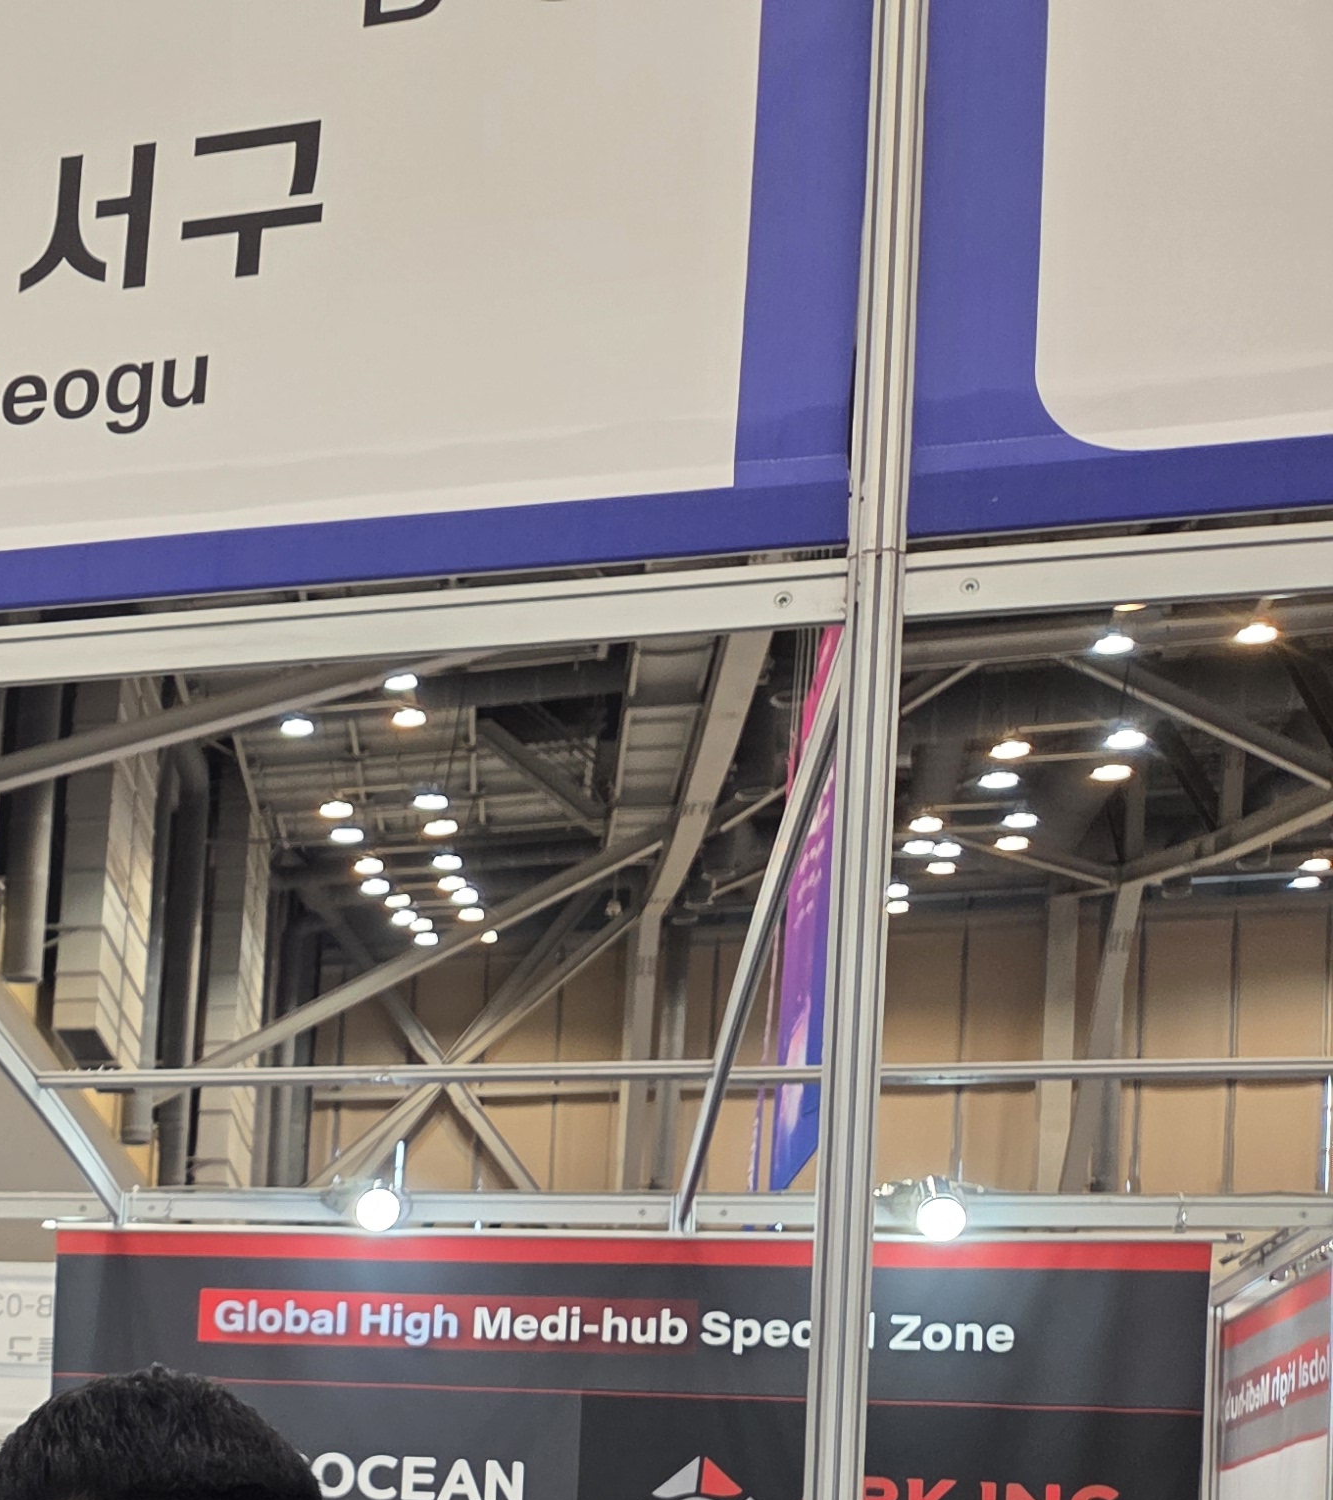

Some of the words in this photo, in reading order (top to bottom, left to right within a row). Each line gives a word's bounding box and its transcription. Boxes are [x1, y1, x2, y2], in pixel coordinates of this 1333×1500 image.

[19, 119, 324, 296] 서구
[213, 1299, 347, 1336] Global
[359, 1302, 459, 1346] High
[472, 1306, 688, 1345] Medi-hub
[889, 1313, 1016, 1353] Zone
